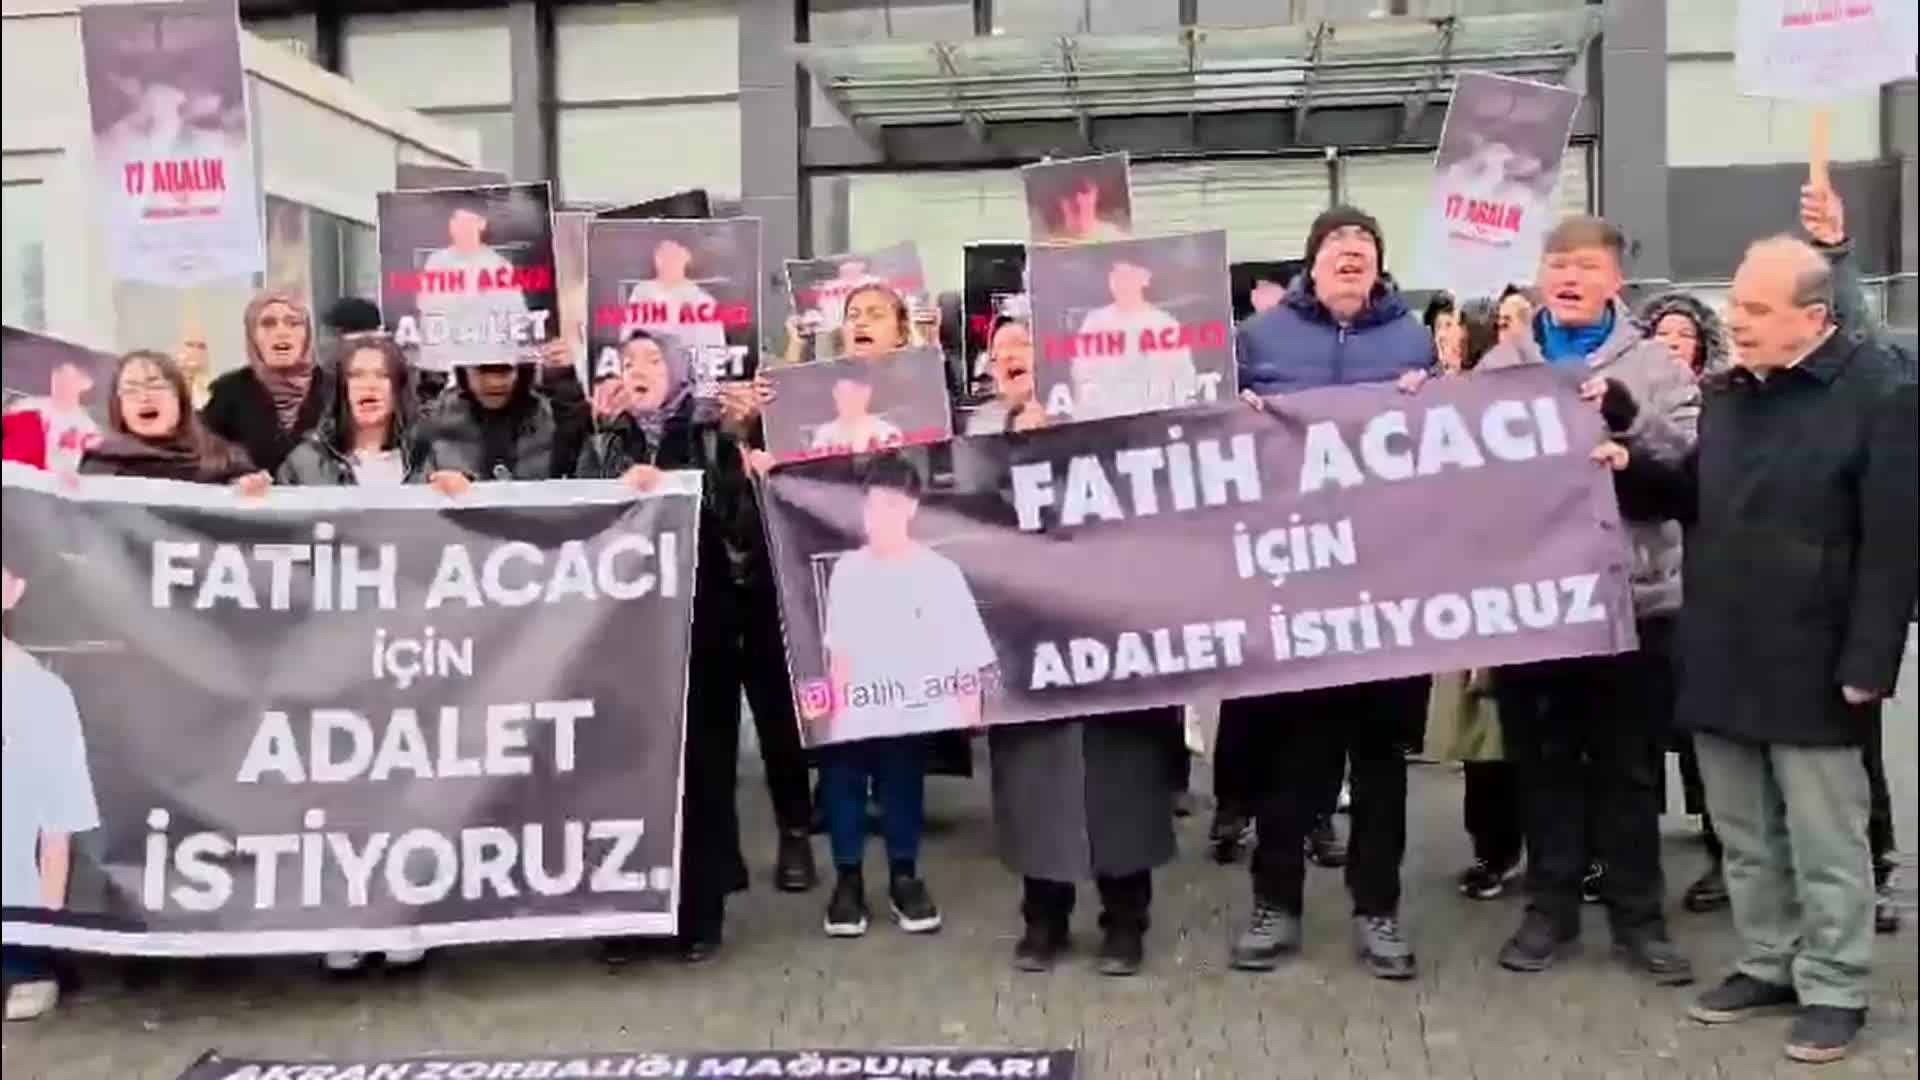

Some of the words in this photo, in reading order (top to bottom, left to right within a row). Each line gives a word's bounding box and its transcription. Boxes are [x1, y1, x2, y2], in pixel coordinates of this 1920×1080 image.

[1010, 424, 1262, 532] FATİH
[1300, 396, 1569, 494] ACACI
[152, 521, 398, 611] FATİH
[426, 532, 679, 609] ACACI
[1233, 511, 1358, 587] İÇİN
[373, 626, 474, 689] İÇİN
[1029, 620, 1247, 690] ADALET
[1271, 574, 1606, 662] İSTİYORUZ
[236, 699, 596, 784] ADALET
[142, 807, 673, 912] İSTİYORUZ.
